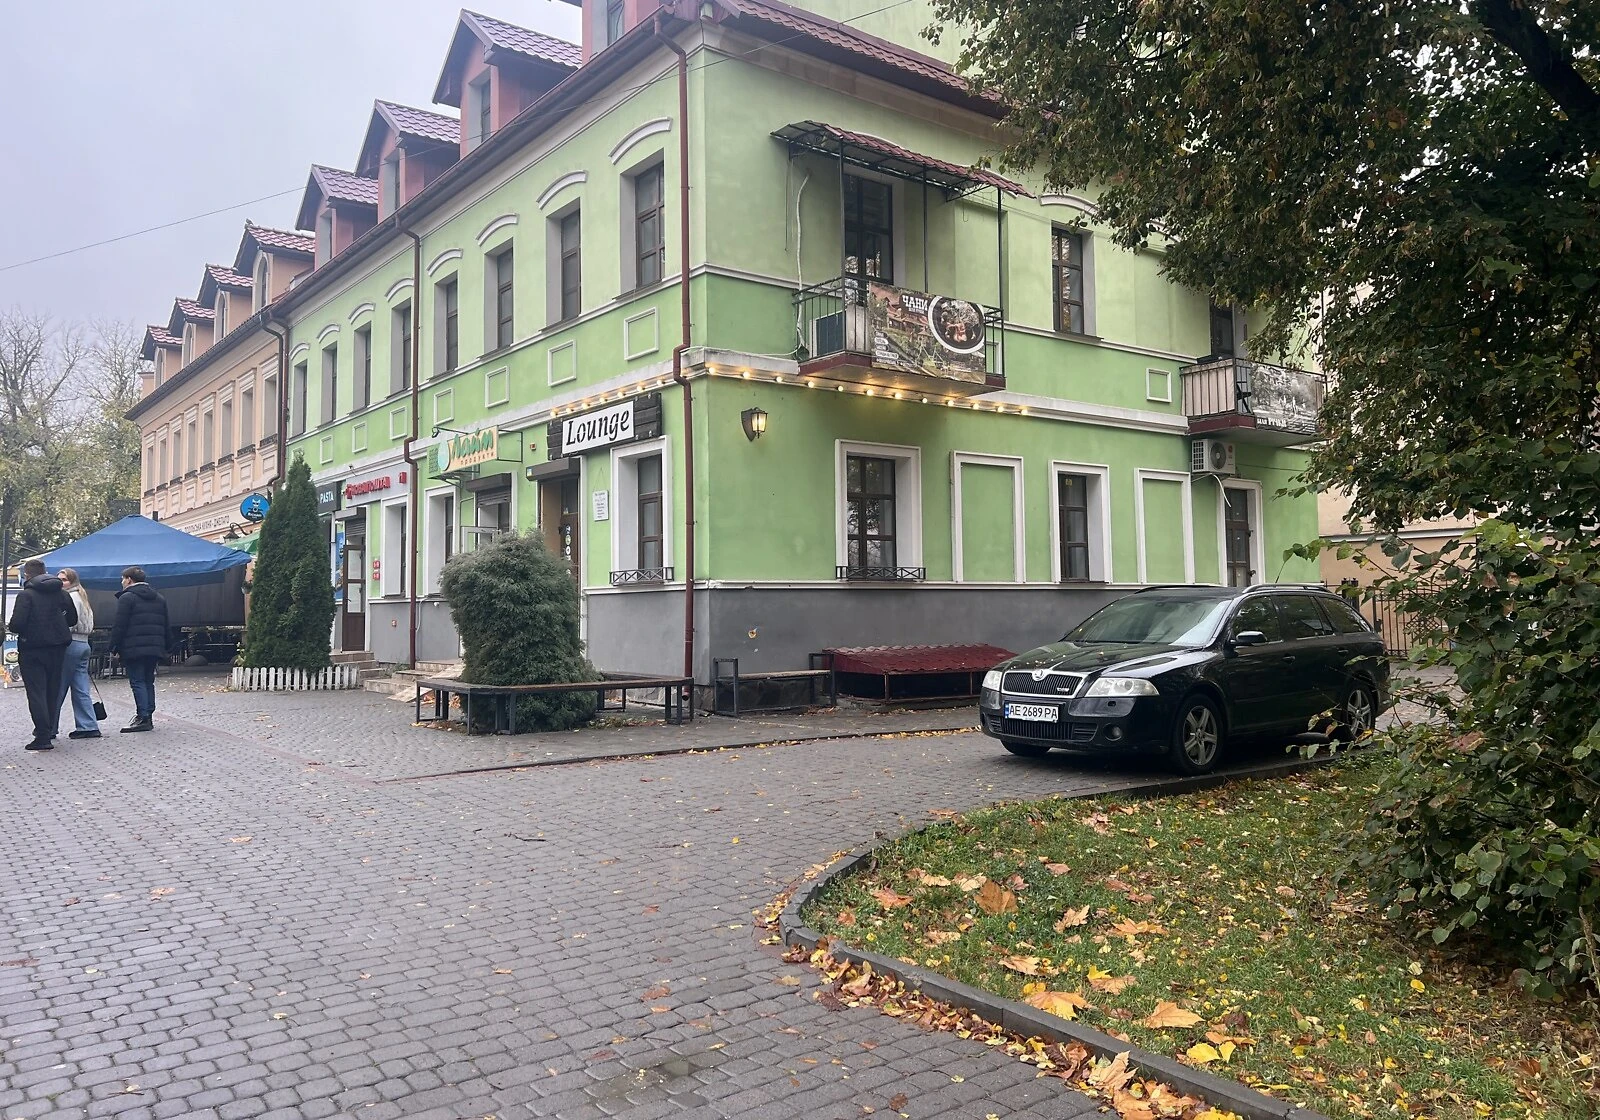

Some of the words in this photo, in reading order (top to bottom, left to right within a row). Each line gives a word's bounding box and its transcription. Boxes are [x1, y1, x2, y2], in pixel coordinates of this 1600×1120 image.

[902, 294, 928, 311] ЧАНИ
[566, 410, 629, 446] Lounge
[320, 490, 334, 504] PASTA
[1009, 705, 1021, 716] AE
[1022, 706, 1043, 718] 2689
[1044, 708, 1058, 719] PA
